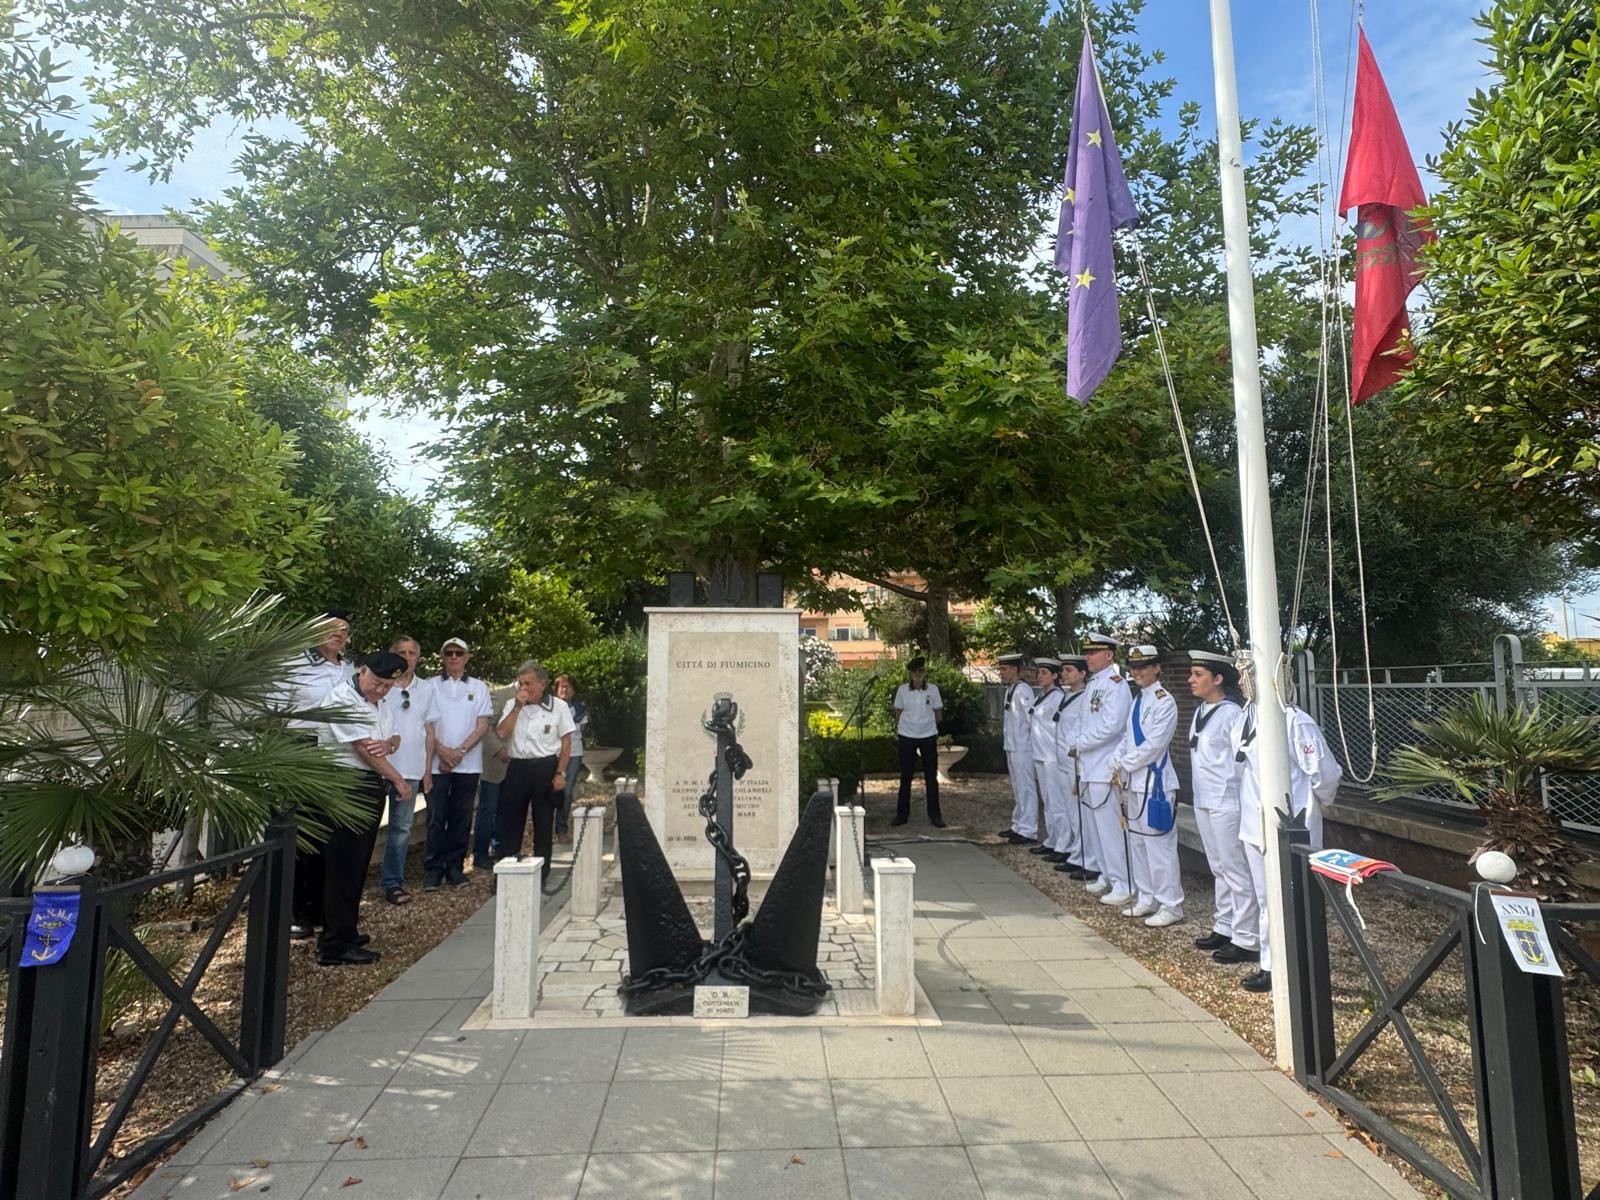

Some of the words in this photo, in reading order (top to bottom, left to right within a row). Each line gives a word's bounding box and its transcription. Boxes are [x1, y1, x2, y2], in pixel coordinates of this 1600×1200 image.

[707, 661, 717, 669] DI
[720, 661, 771, 669] FIUMICINO
[1502, 903, 1535, 918] ANMI
